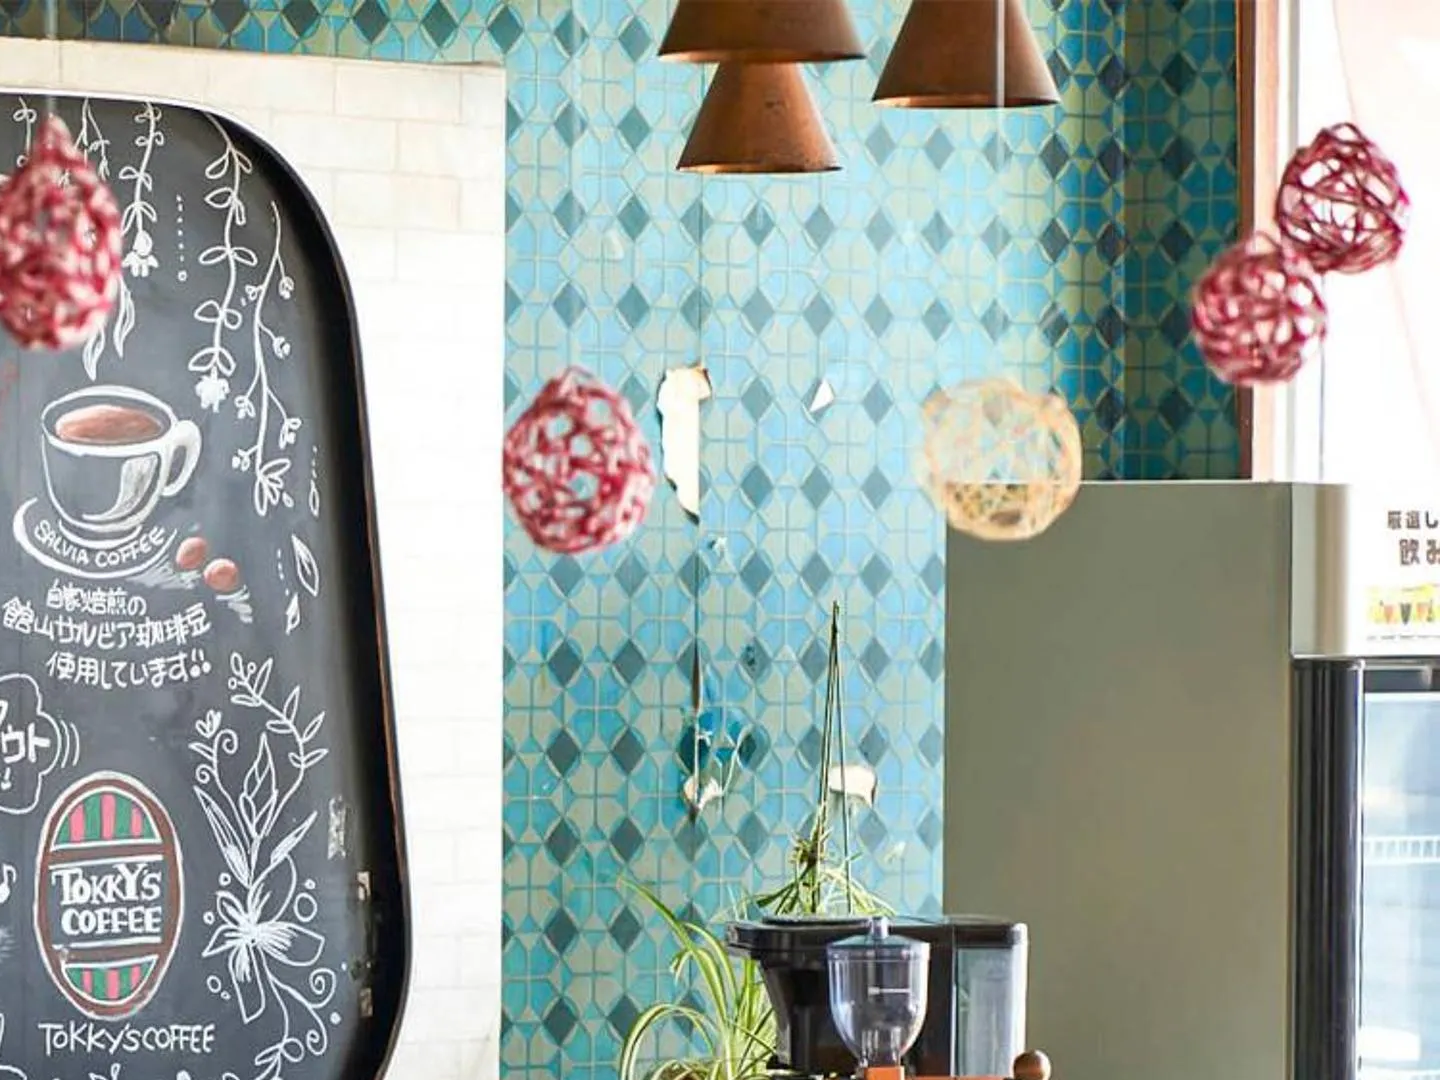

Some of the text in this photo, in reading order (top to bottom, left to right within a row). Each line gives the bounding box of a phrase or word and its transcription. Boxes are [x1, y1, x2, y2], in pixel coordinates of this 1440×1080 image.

[33, 519, 166, 567] SALVIA COFFEE
[46, 578, 148, 617] 自家焙煎の
[1, 596, 212, 650] 館山サルビア珈琲豆
[61, 905, 162, 937] COFFEE
